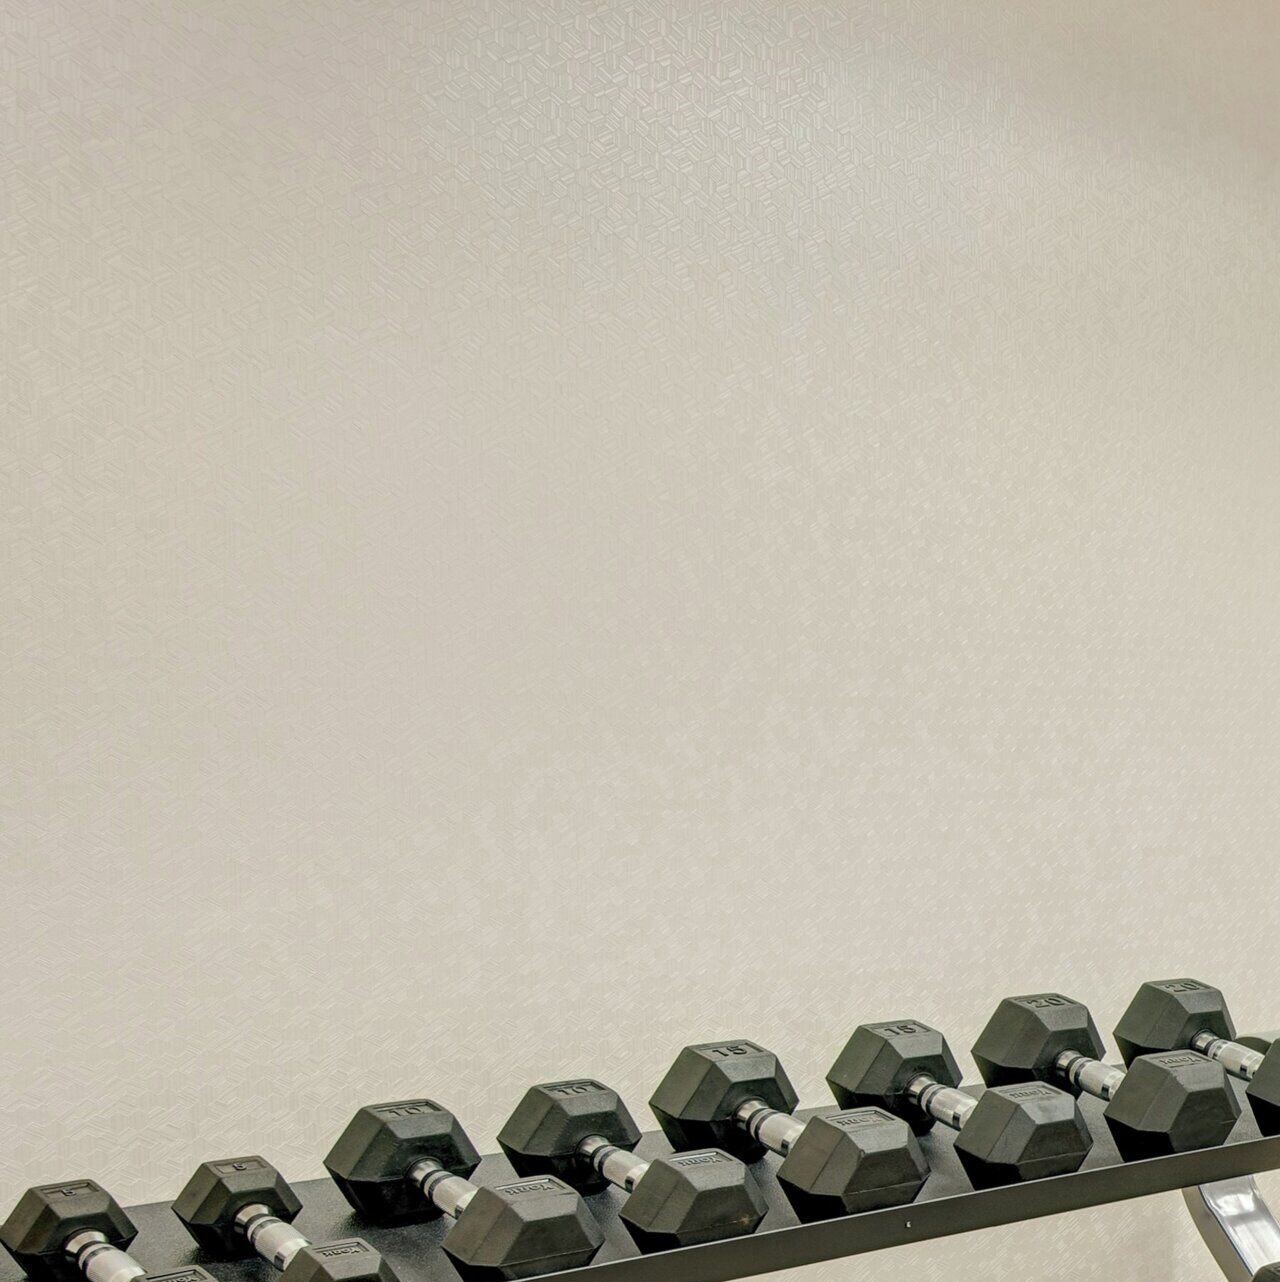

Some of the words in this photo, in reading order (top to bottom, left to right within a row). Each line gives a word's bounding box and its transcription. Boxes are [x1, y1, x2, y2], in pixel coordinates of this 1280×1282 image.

[884, 1025, 917, 1036] 15
[712, 1045, 748, 1057] 15
[556, 1085, 588, 1096] 10
[388, 1106, 423, 1117] 10
